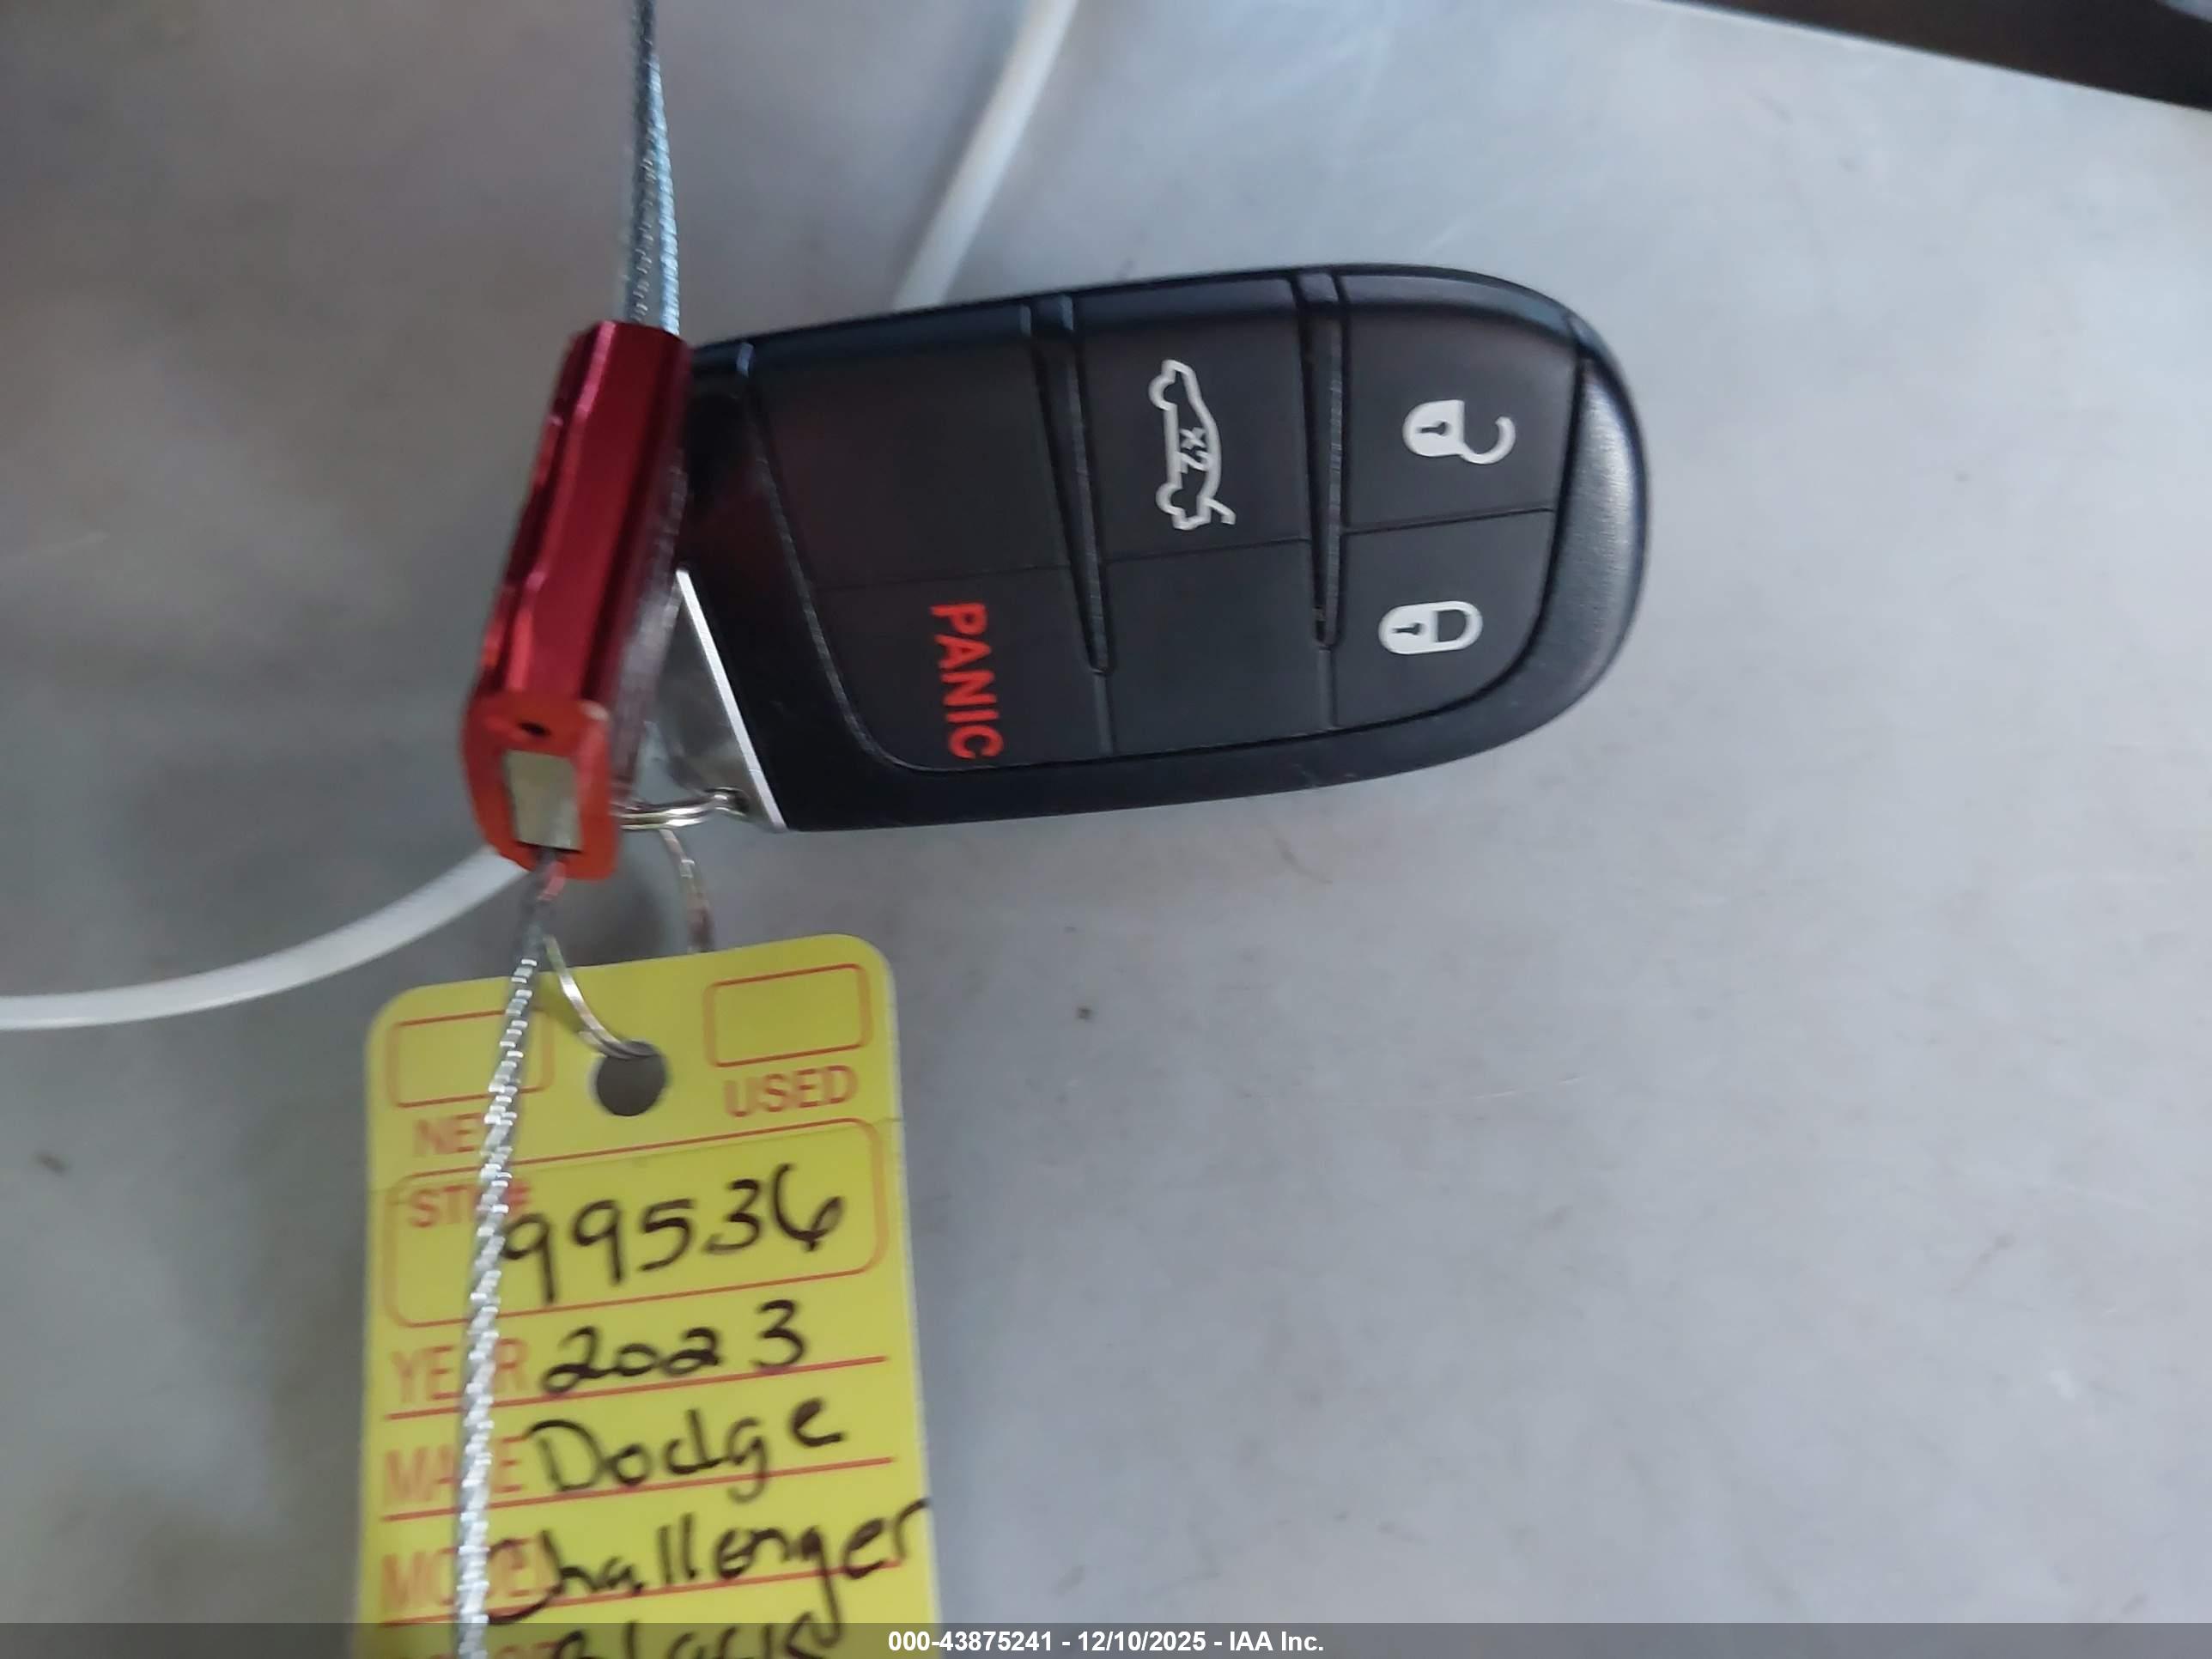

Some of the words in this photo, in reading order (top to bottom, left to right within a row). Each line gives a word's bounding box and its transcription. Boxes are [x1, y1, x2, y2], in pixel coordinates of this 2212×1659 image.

[929, 600, 1005, 760] PANIC
[412, 1112, 486, 1157] NE
[723, 1065, 859, 1117] USED
[501, 1163, 845, 1304] 99536
[389, 1338, 530, 1403] YER
[540, 1298, 806, 1395] 2023
[383, 1436, 524, 1504] MAE
[526, 1398, 848, 1504] Dodge
[487, 1497, 931, 1647] Challenger
